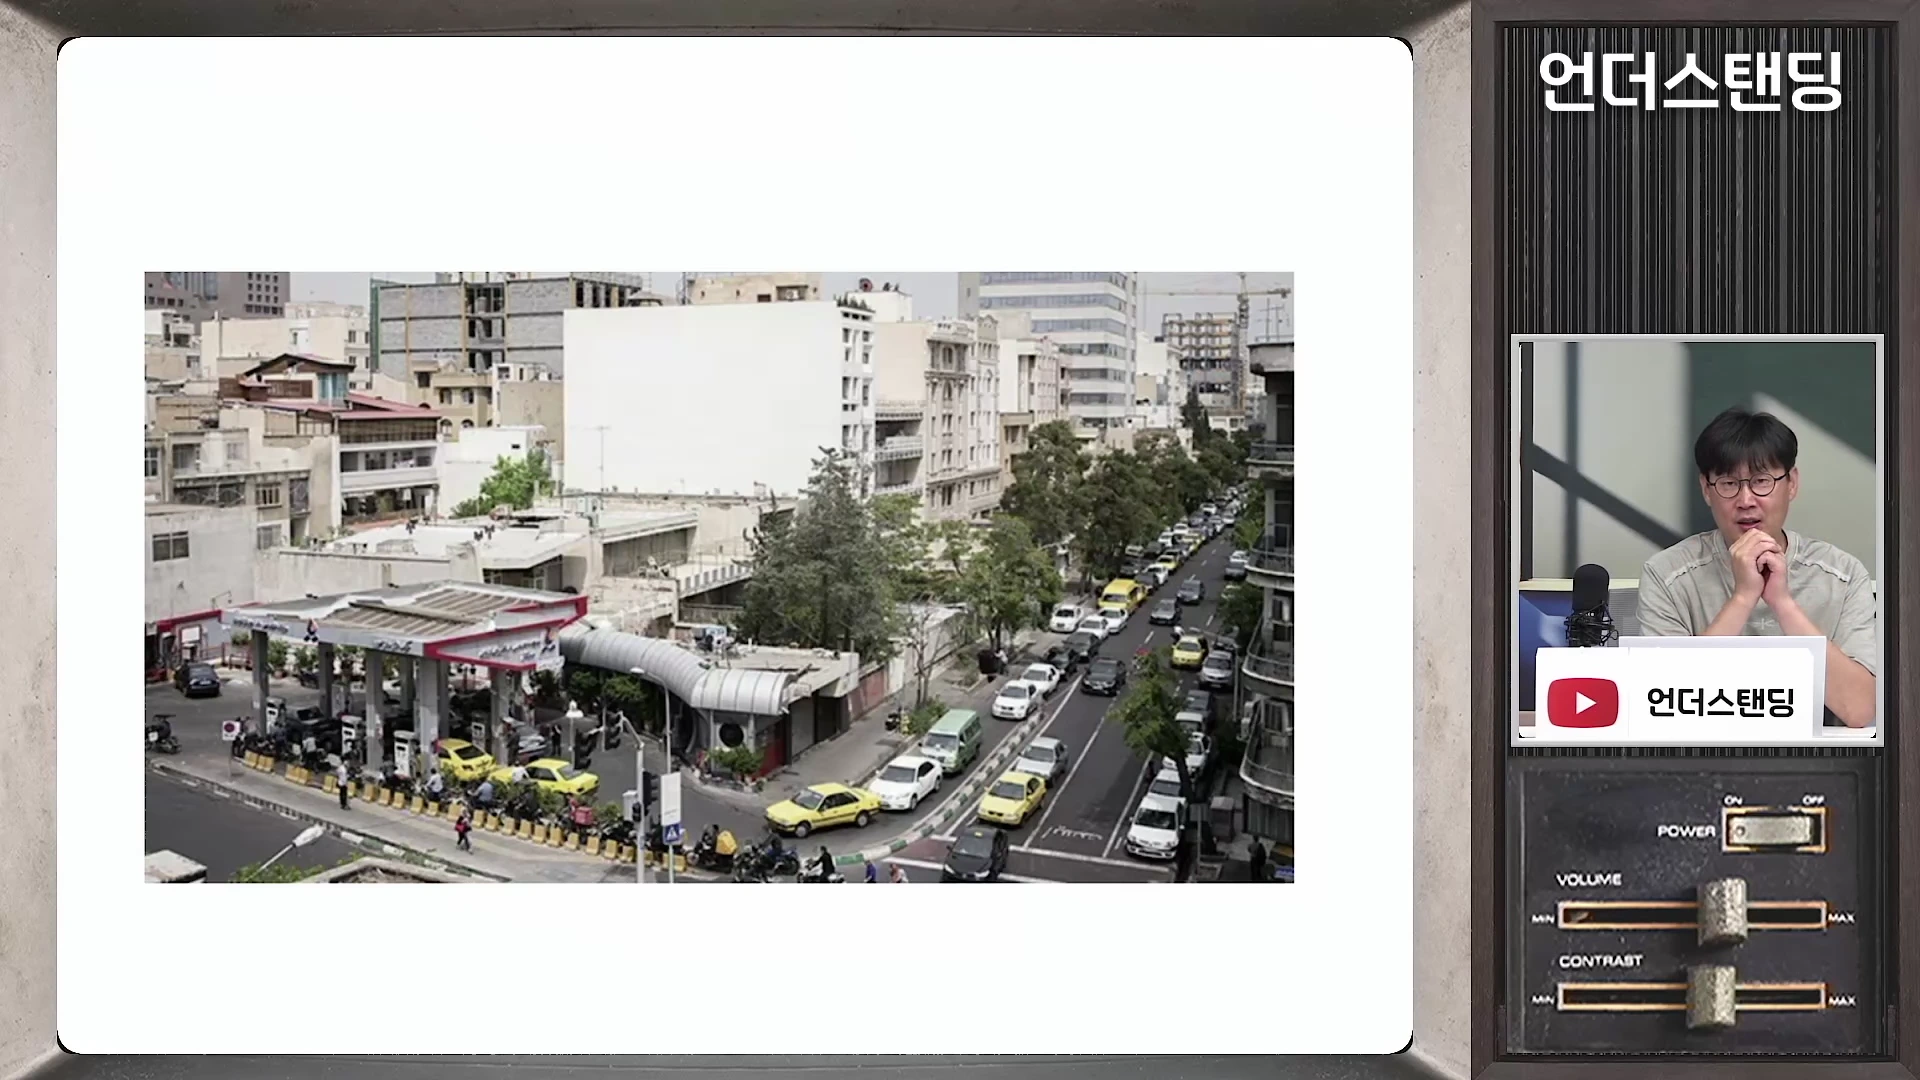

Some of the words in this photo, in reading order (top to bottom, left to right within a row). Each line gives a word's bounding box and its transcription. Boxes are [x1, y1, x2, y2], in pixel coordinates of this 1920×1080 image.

[1647, 687, 1795, 718] 언더스탠딩
[1724, 794, 1743, 806] ON
[1802, 794, 1825, 806] OFF
[1657, 824, 1716, 838] POWER
[1556, 873, 1622, 887] VOLUME
[1531, 914, 1555, 924] MIN
[1828, 913, 1855, 923] MAX
[1559, 954, 1643, 968] CONTRAST
[1531, 995, 1555, 1005] MIN
[1829, 996, 1856, 1006] MAX
